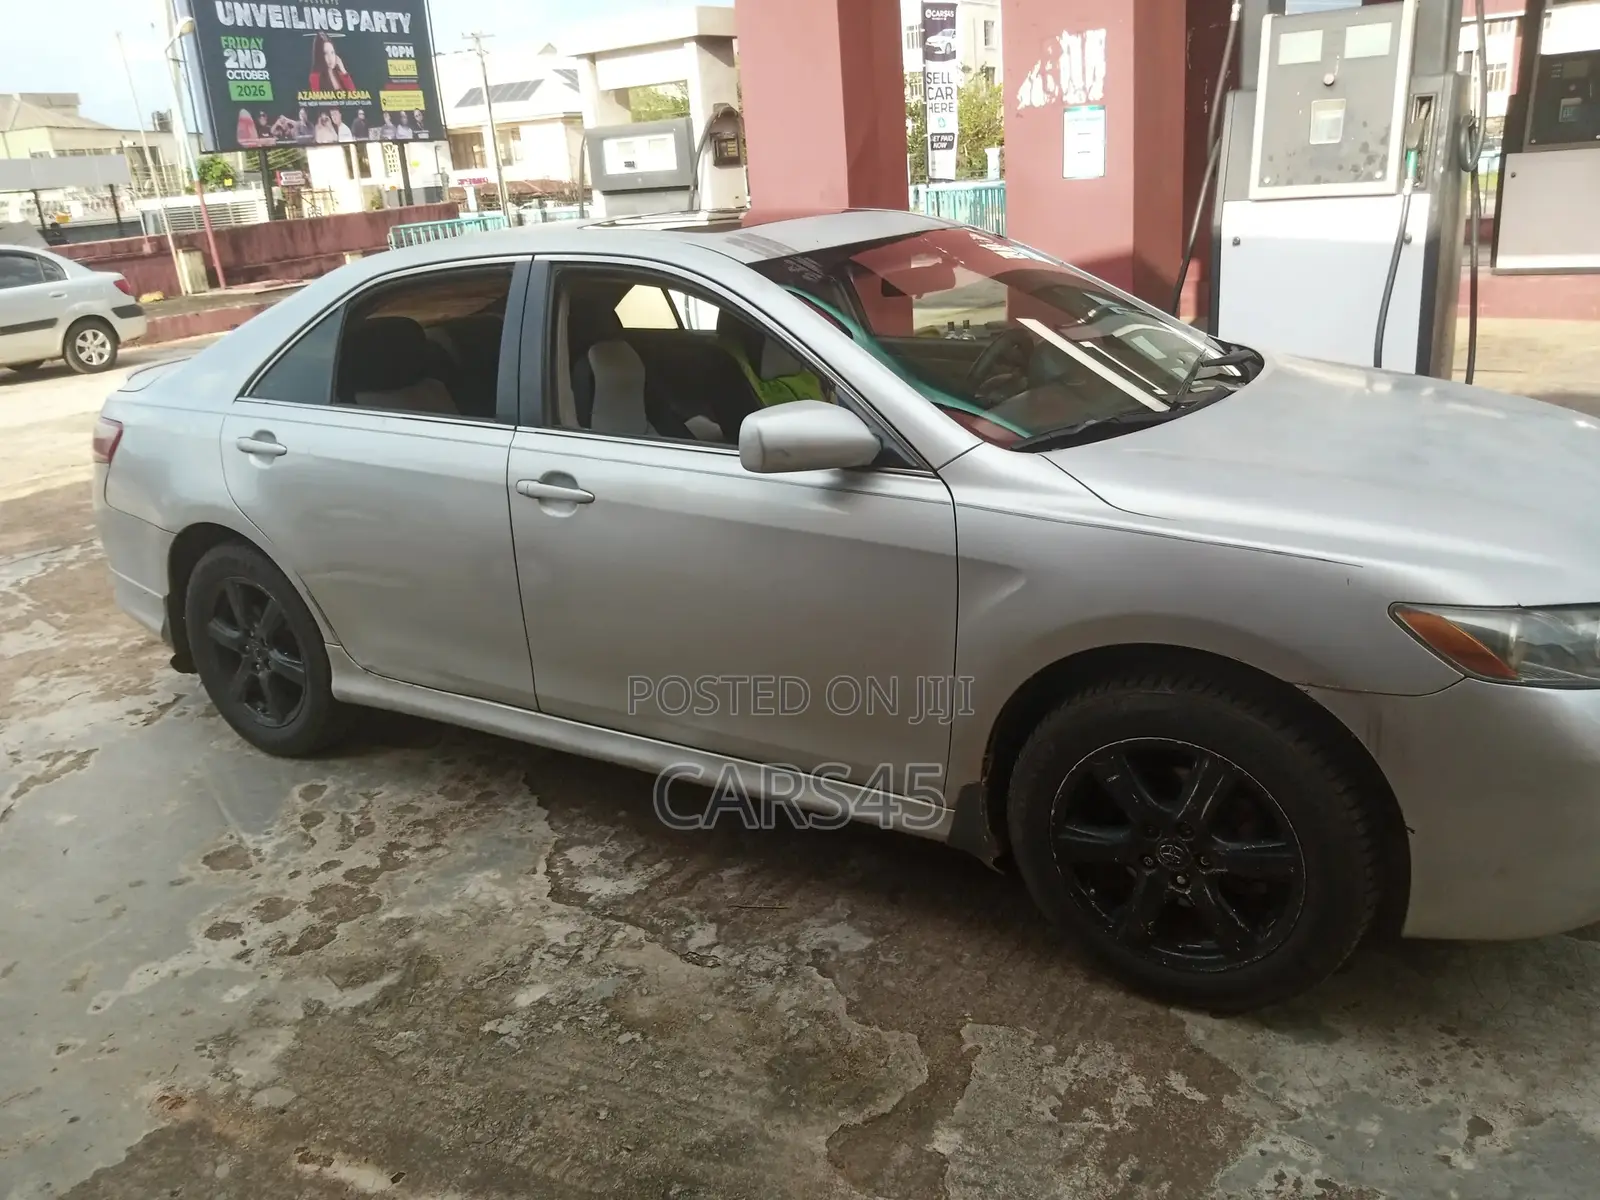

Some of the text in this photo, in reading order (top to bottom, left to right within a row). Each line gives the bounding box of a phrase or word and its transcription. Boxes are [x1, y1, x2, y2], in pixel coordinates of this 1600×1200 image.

[215, 1, 411, 34] UNVEILING PARTY
[221, 36, 264, 50] FRIDAY
[385, 45, 415, 58] 10PM
[223, 48, 267, 69] 2ND
[226, 69, 270, 80] OCTOBER
[926, 72, 953, 84] SELL
[236, 84, 266, 97] 2026
[337, 90, 347, 100] OF
[347, 90, 372, 100] ASABA
[928, 86, 954, 101] CAR
[929, 102, 955, 114] HERE
